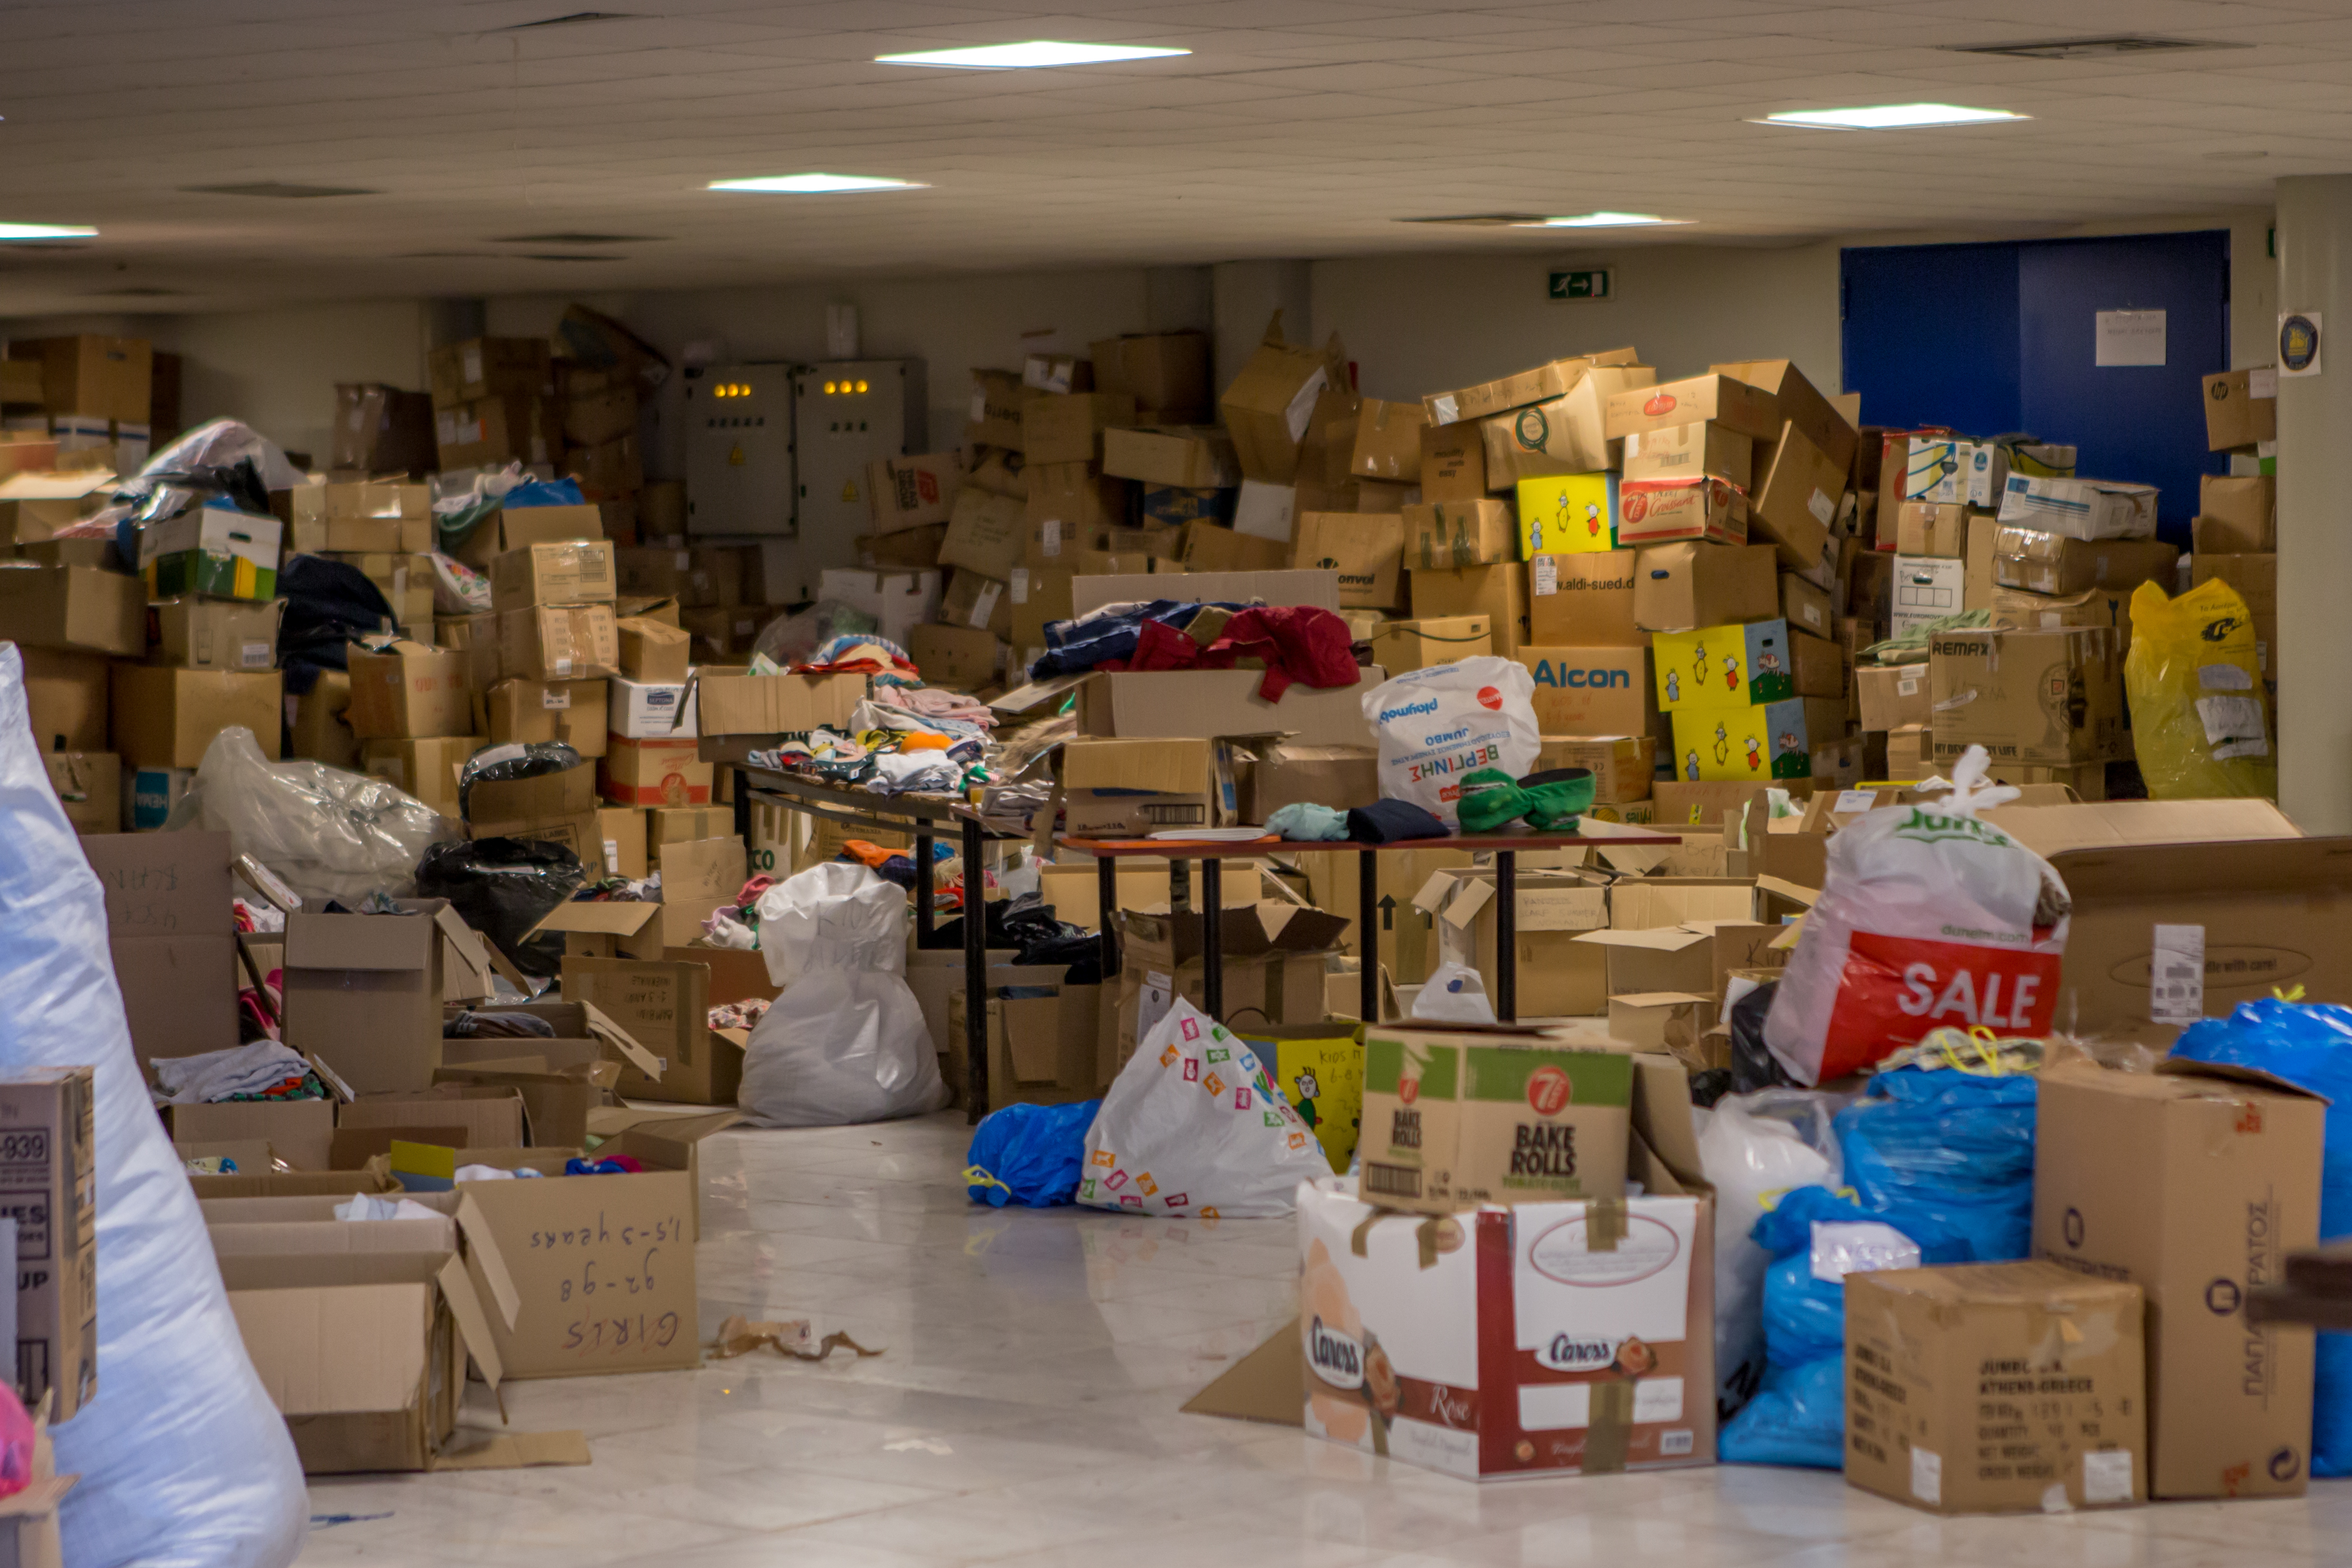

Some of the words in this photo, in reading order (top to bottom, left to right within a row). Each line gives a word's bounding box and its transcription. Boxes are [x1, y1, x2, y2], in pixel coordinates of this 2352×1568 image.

[1650, 494, 1700, 518] Croissant
[1337, 574, 1375, 585] onvoi
[1556, 577, 1634, 590] w.aldi-sued.d
[1932, 642, 1989, 656] REMAX
[1533, 659, 1630, 689] Alcon
[1378, 697, 1439, 724] playmob
[1425, 727, 1469, 747] JUMBO
[1934, 743, 1947, 755] MY
[1999, 745, 2017, 756] LIFE
[1408, 744, 1499, 783] ΒΕΡΓΙΝΗΣ
[136, 792, 168, 810] HEMA
[1941, 924, 2029, 943] dunelm.com
[1896, 961, 2041, 1029] SALE
[1319, 1050, 1346, 1063] KIDS
[1330, 1068, 1354, 1083] 6-8
[1394, 1110, 1422, 1129] BAKE
[1392, 1129, 1422, 1149] ROLLS
[1516, 1124, 1577, 1150] BAKE
[1510, 1150, 1577, 1177] ROLLS
[531, 1211, 611, 1249] years
[2244, 1201, 2268, 1397] ΠΑΠΑΡΑΤΟΣ
[566, 1311, 678, 1349] GIRLS
[1311, 1314, 1361, 1375] Caress
[1549, 1332, 1612, 1366] Caress
[1979, 1377, 2094, 1396] ATHENS-GREECE
[1430, 1384, 1472, 1426] Rose
